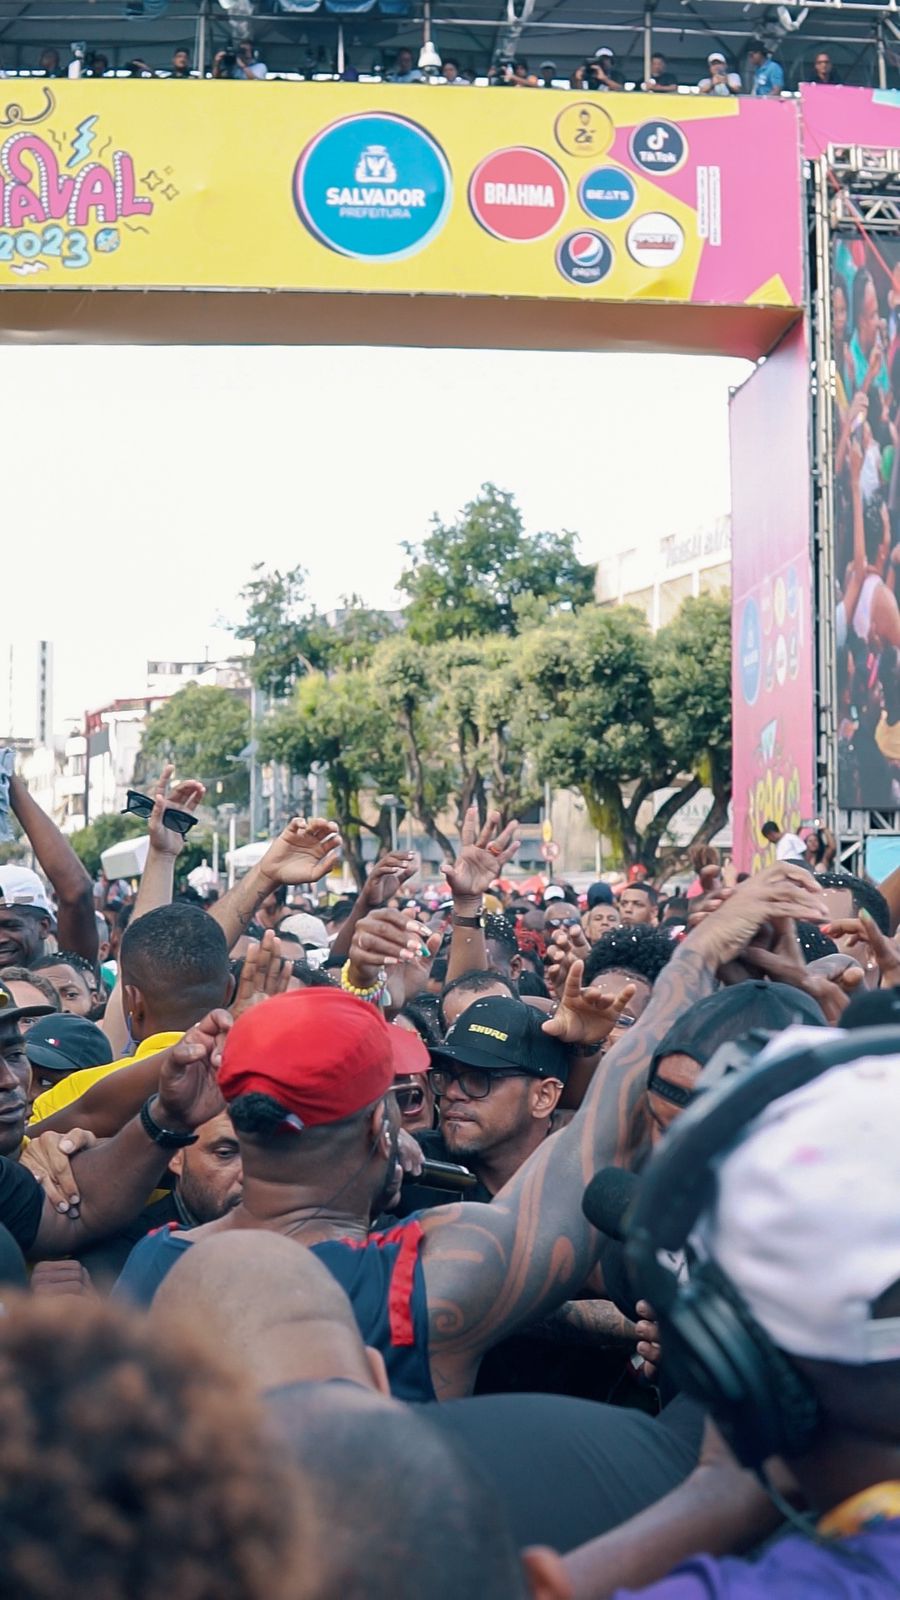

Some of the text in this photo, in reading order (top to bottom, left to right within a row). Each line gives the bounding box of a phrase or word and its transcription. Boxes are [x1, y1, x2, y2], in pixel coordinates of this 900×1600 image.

[325, 187, 426, 207] SALVADOR
[484, 182, 555, 208] BRAHMA
[585, 188, 630, 201] BEATS
[339, 206, 411, 219] PREFEITURA
[0, 224, 91, 269] 2023
[468, 1023, 509, 1042] SHURE
